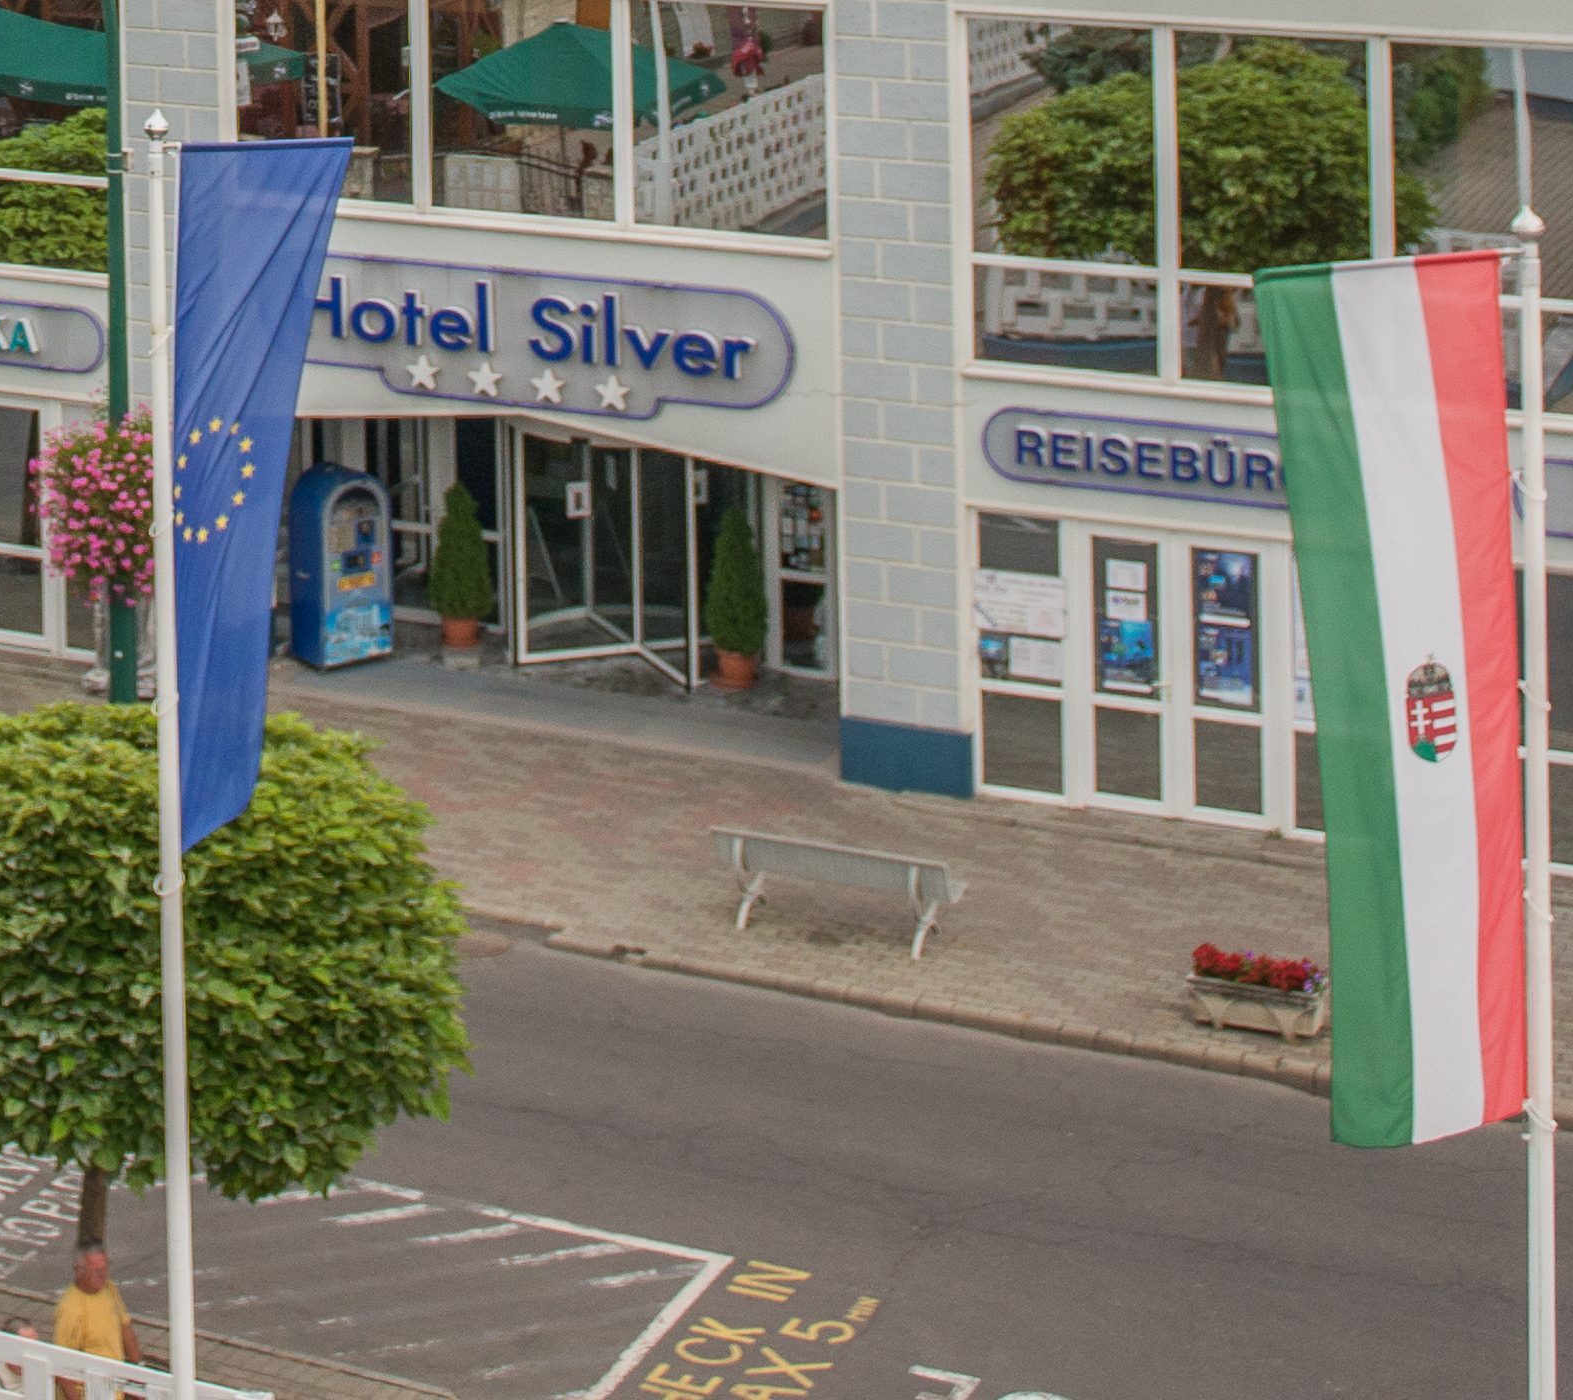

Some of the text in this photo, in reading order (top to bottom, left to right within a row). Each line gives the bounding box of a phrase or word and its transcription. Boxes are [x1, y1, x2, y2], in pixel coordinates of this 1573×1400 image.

[314, 274, 758, 380] Hotel Silver
[1015, 424, 1286, 491] REISEBÜR
[639, 1260, 813, 1400] HECK IN
[778, 1317, 855, 1345] 5
[729, 1346, 835, 1400] AX
